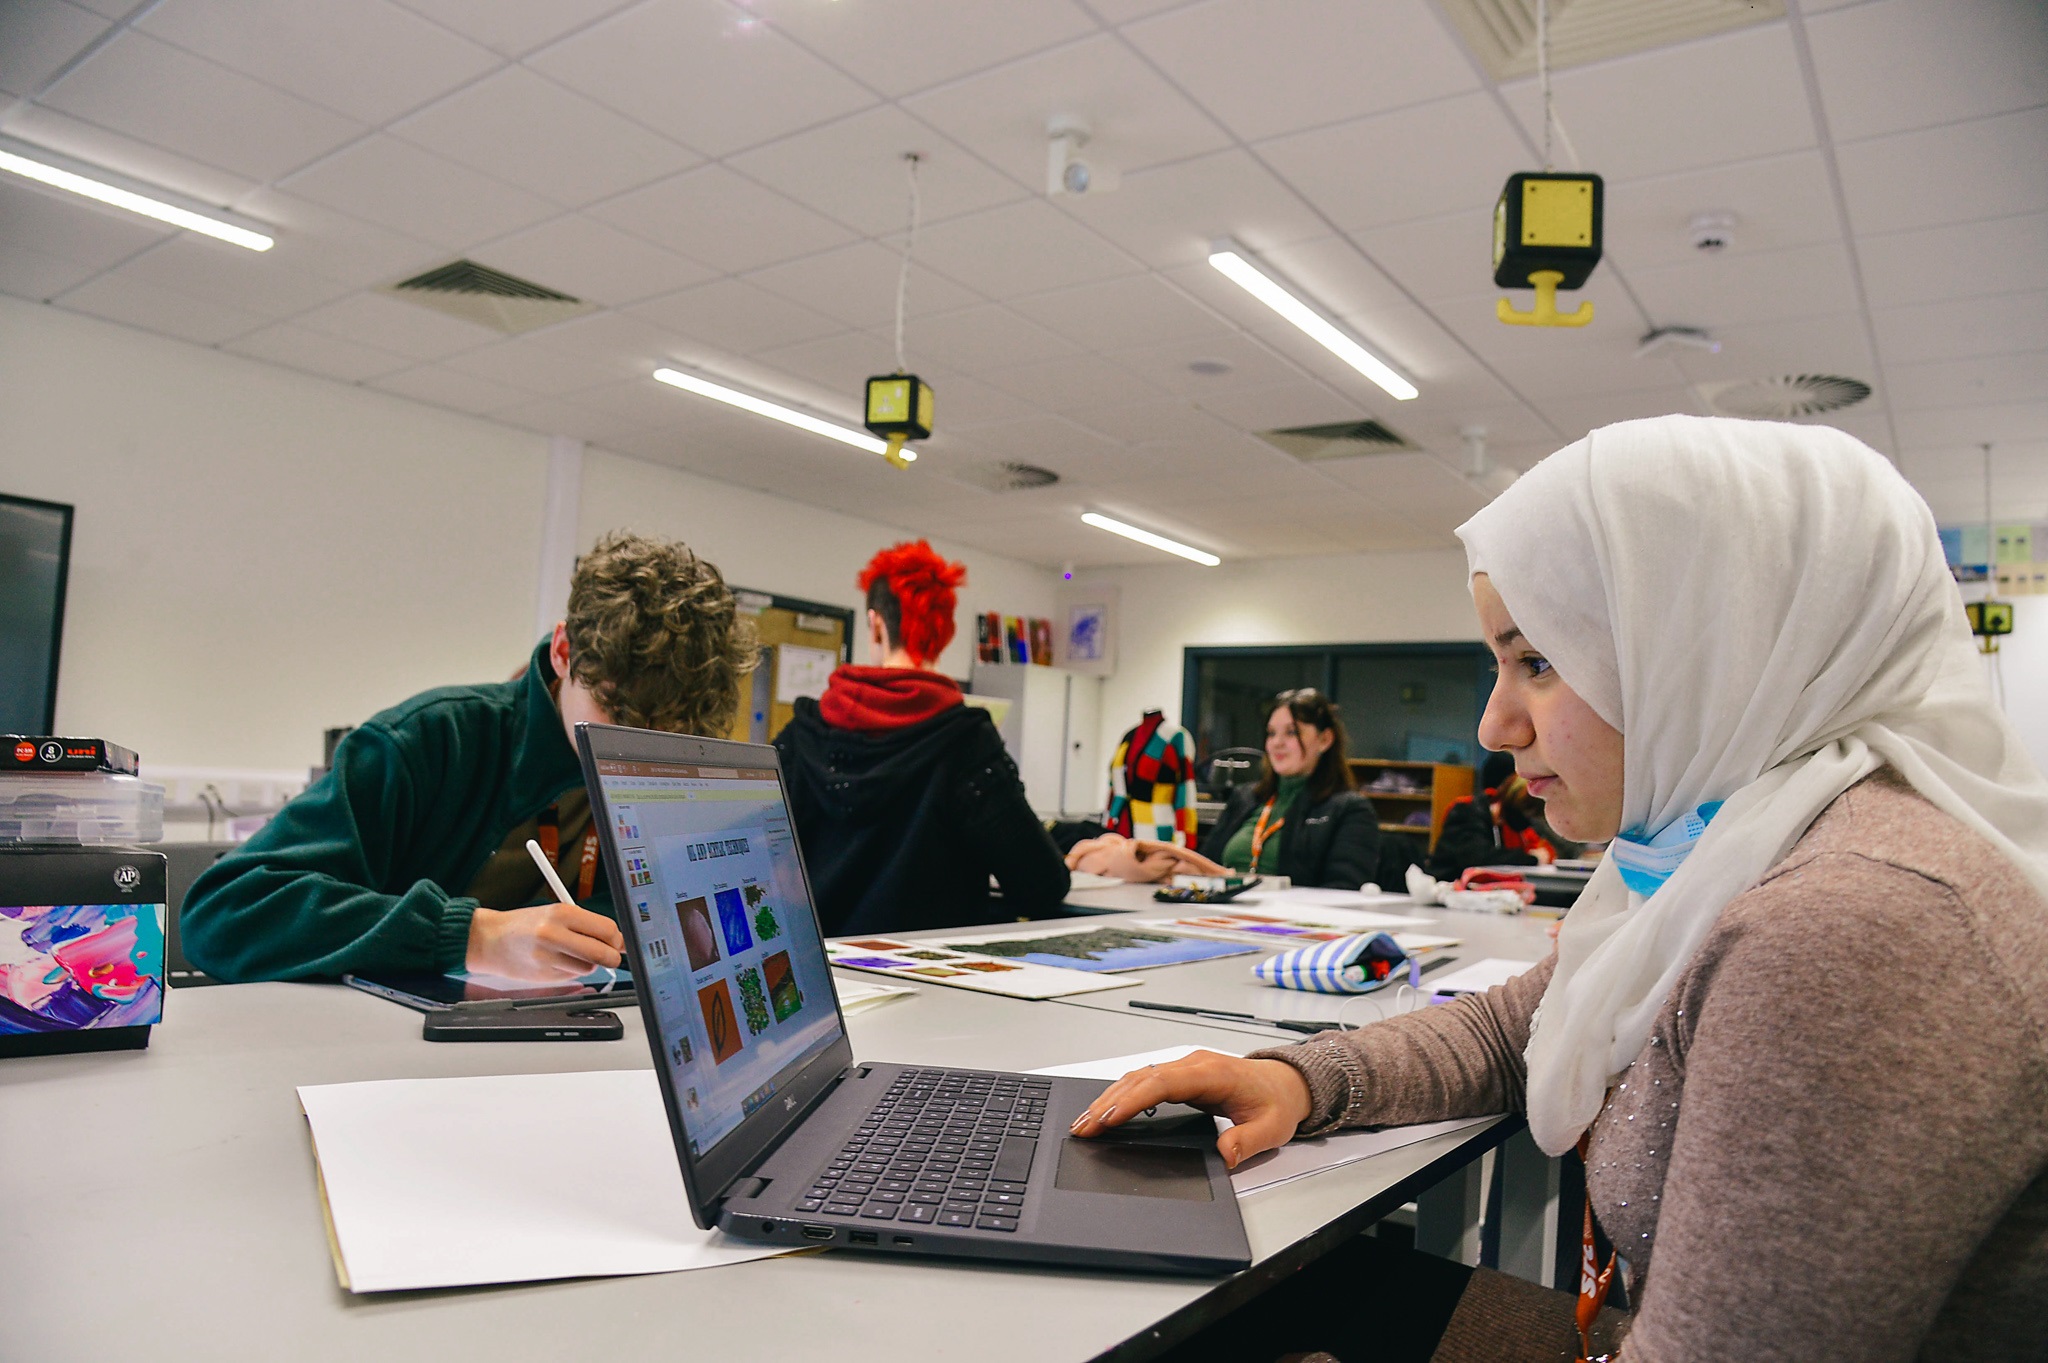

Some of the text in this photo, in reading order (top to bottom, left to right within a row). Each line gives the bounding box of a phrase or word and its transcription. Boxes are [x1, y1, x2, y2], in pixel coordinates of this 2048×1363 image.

[48, 745, 55, 754] 8
[67, 746, 97, 755] uni
[119, 870, 136, 883] AP
